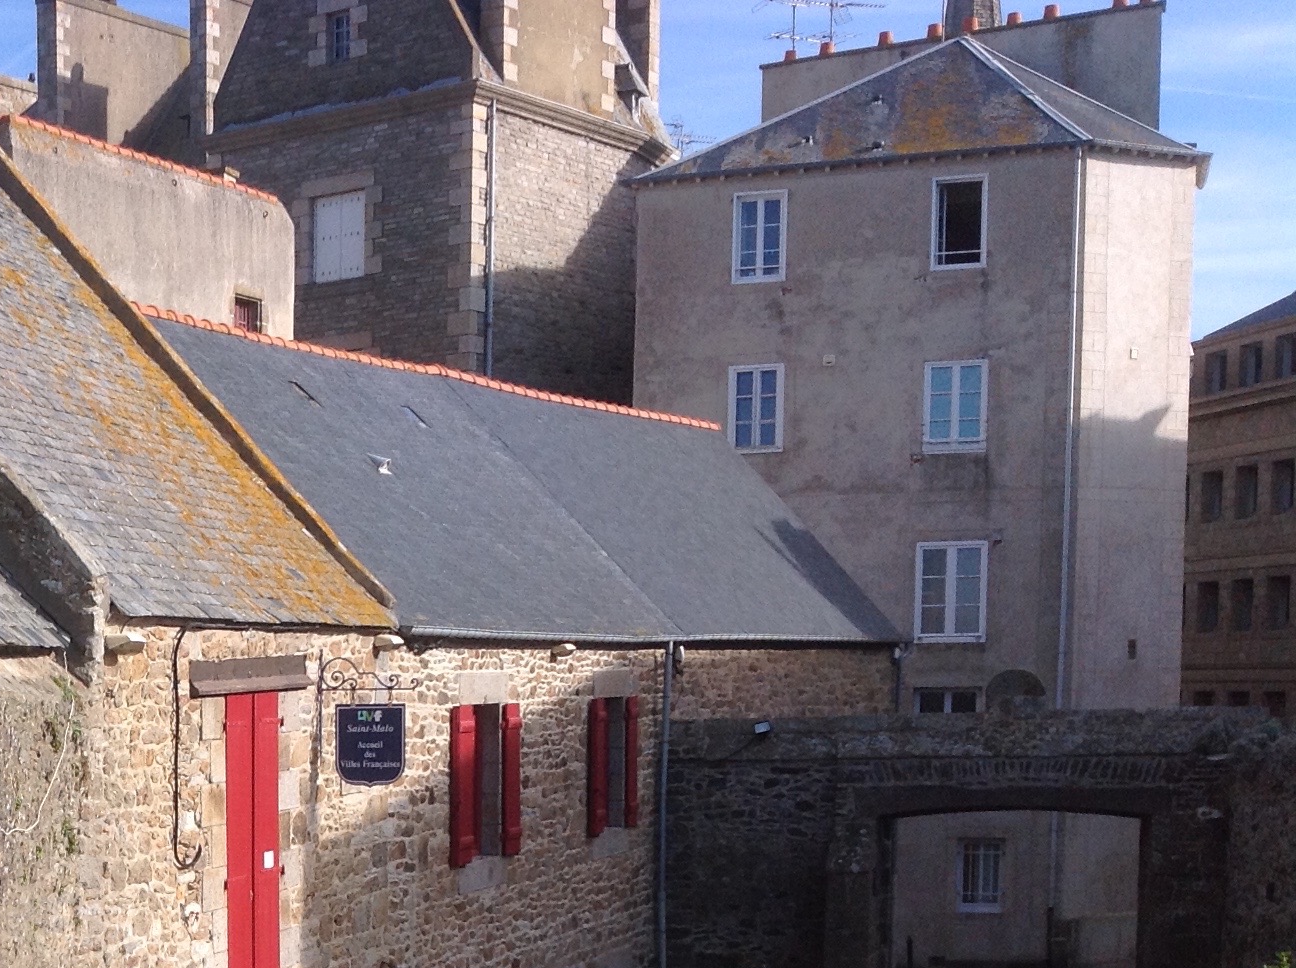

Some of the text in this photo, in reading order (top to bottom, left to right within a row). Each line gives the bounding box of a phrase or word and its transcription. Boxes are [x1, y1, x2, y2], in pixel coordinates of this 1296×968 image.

[347, 724, 394, 733] Saint-Malo
[364, 750, 376, 758] des
[341, 760, 400, 770] Villes Françaises
